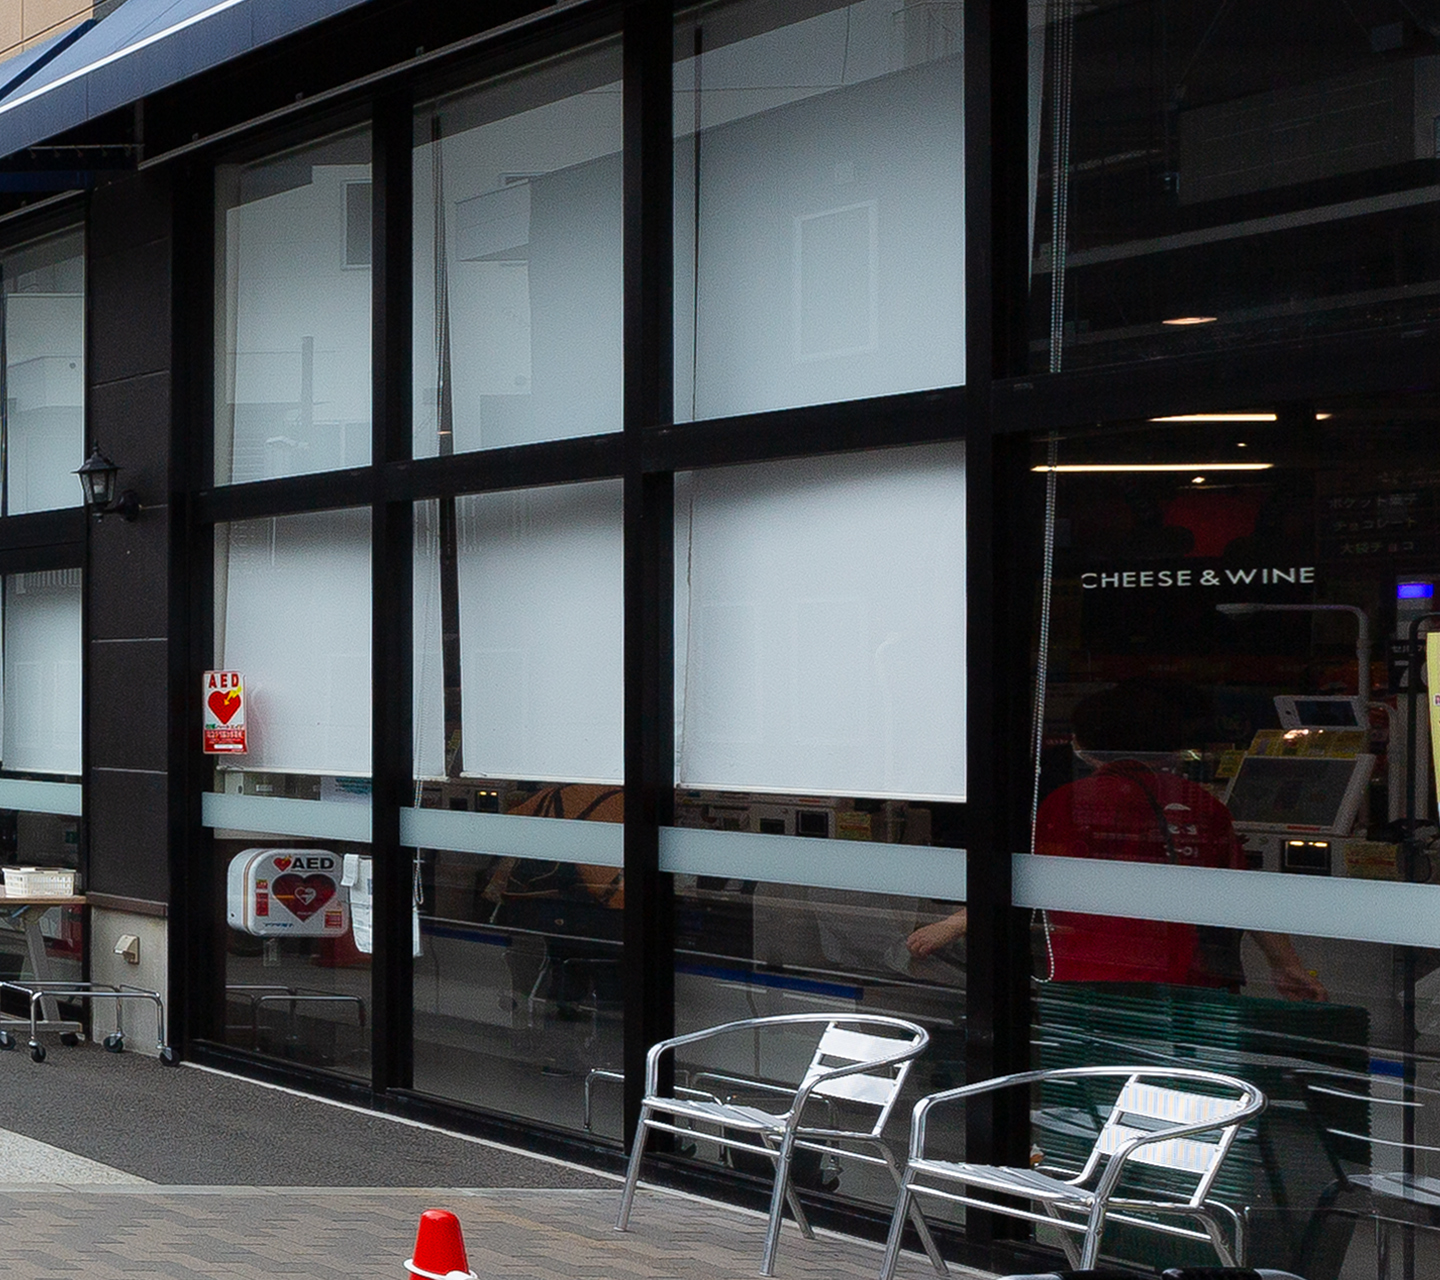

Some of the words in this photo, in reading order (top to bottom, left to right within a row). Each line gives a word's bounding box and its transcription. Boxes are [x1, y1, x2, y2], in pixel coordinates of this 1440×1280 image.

[1081, 570, 1192, 590] CHEESE
[1201, 569, 1220, 586] &
[1224, 567, 1316, 585] WINE
[208, 674, 240, 688] AED
[291, 857, 335, 870] AED
